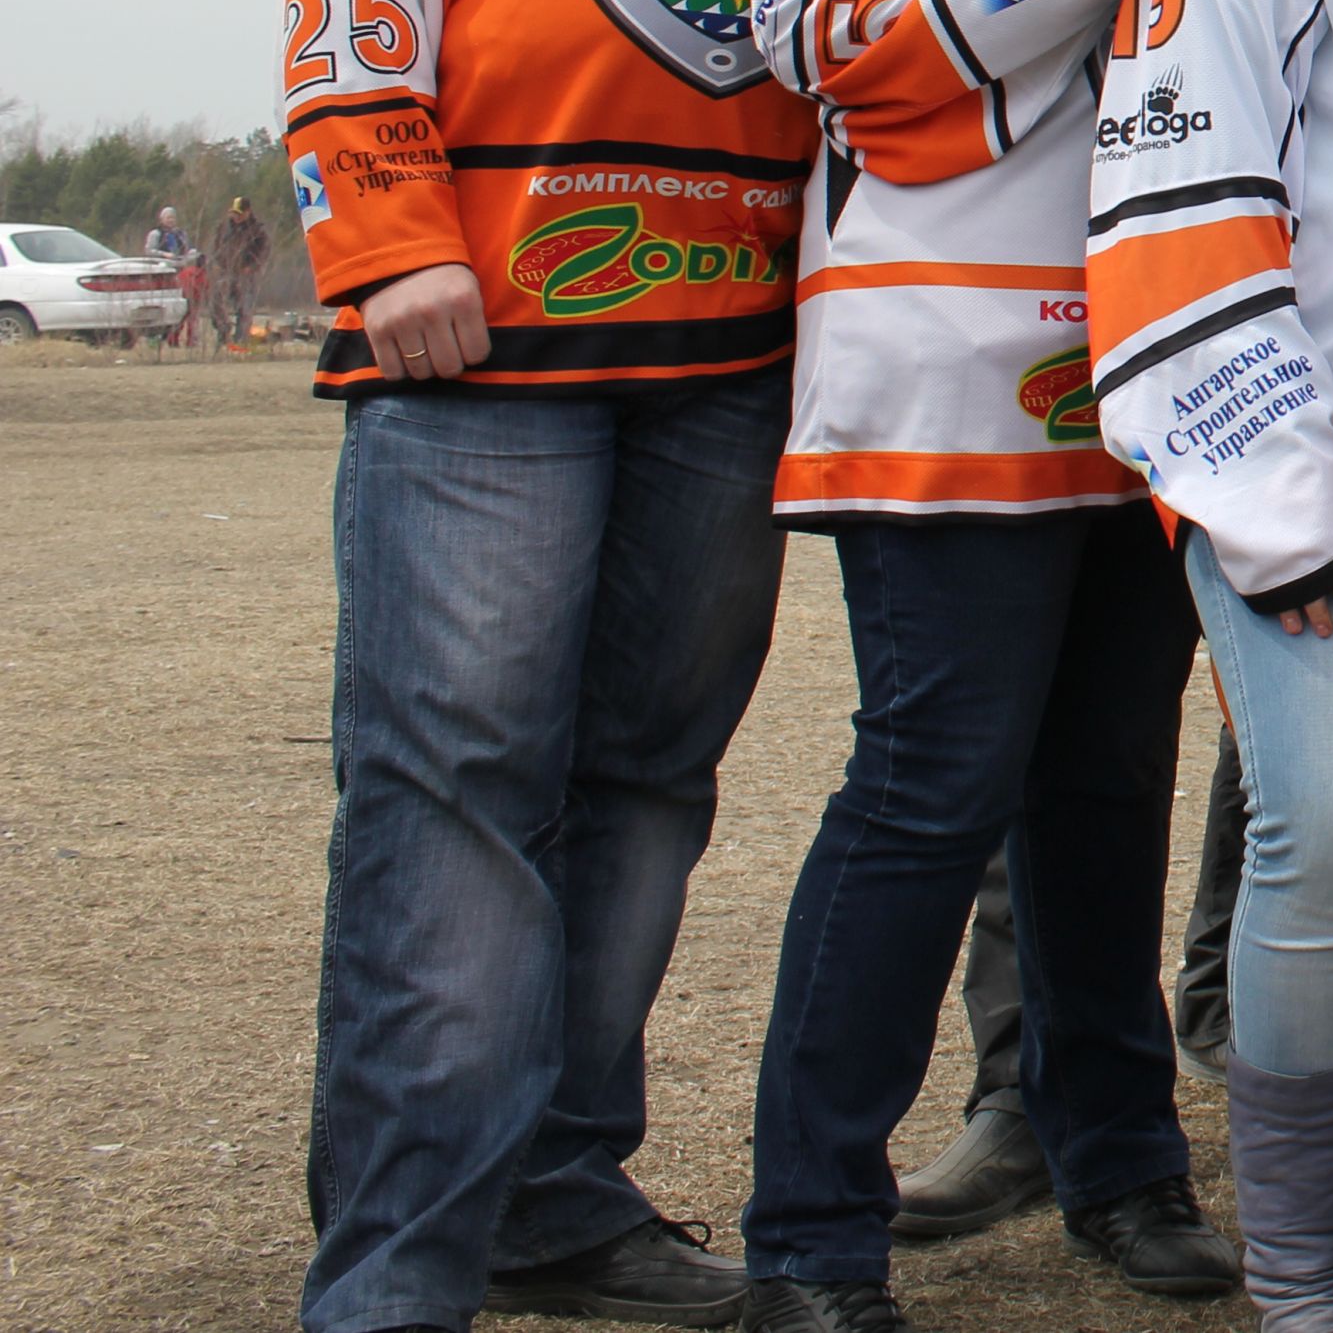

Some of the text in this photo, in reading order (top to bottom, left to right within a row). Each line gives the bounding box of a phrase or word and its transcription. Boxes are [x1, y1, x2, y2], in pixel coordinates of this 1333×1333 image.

[375, 119, 430, 145] ООО
[508, 201, 780, 318] ZODI
[1166, 355, 1313, 456] Строительное
[1171, 336, 1281, 422] Ангарское
[1202, 382, 1319, 476] управление
